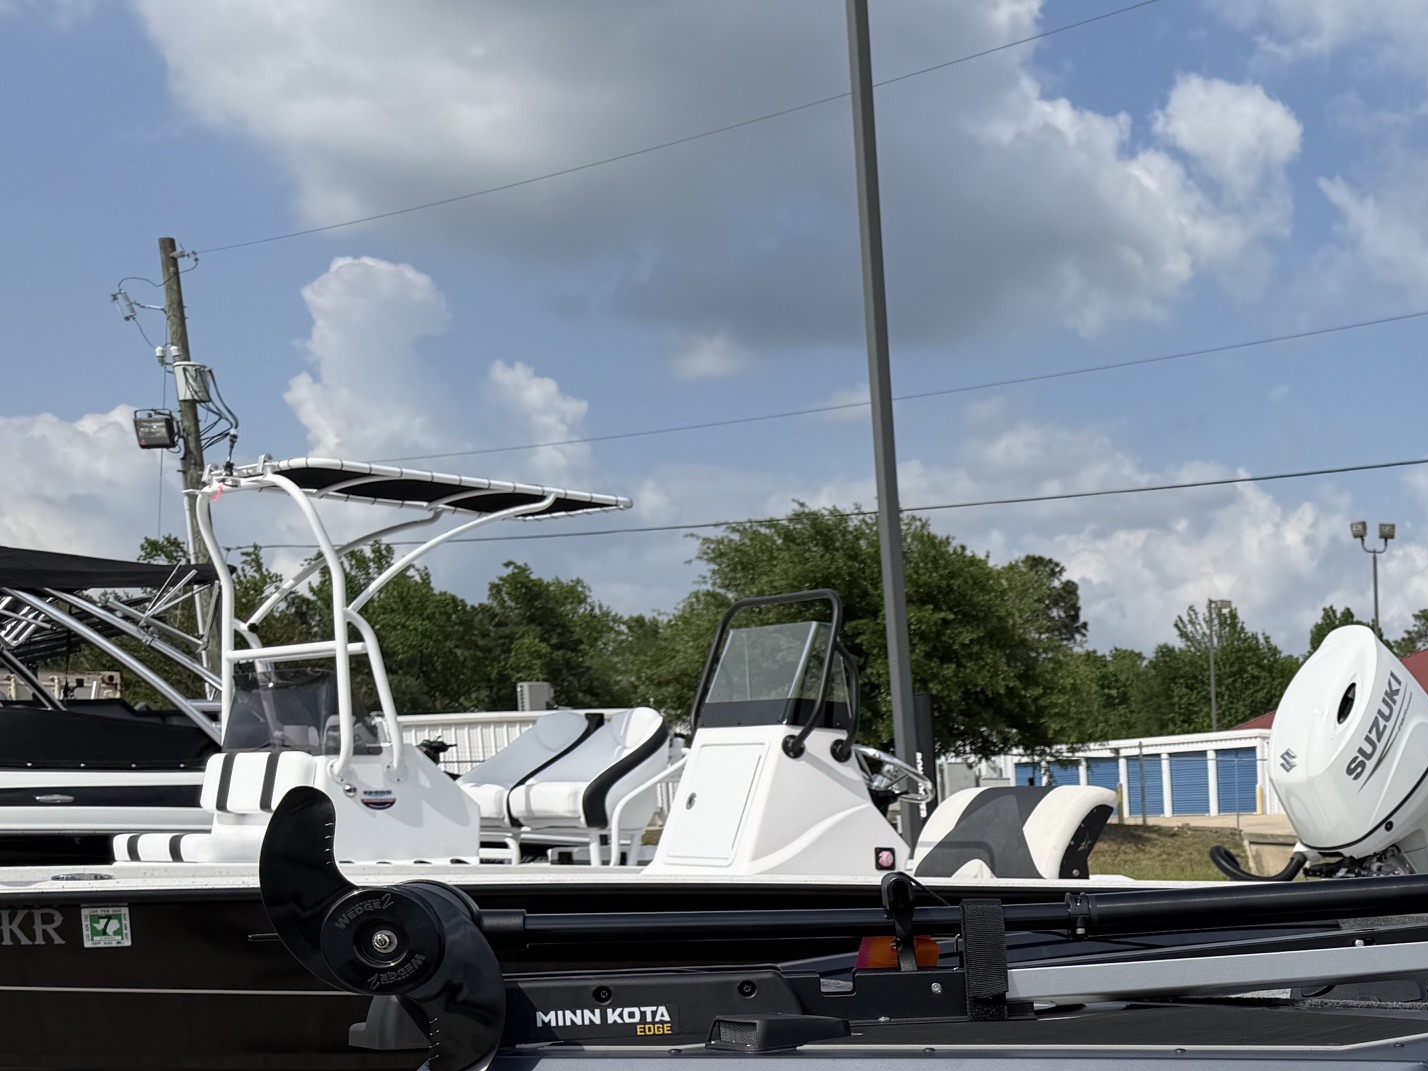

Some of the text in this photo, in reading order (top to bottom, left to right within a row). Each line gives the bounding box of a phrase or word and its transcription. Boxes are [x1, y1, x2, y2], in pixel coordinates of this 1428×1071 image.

[1345, 671, 1402, 781] SUZUKI
[0, 908, 66, 945] KR
[536, 1005, 671, 1027] MINN KOTA
[636, 1023, 672, 1036] EDGE
